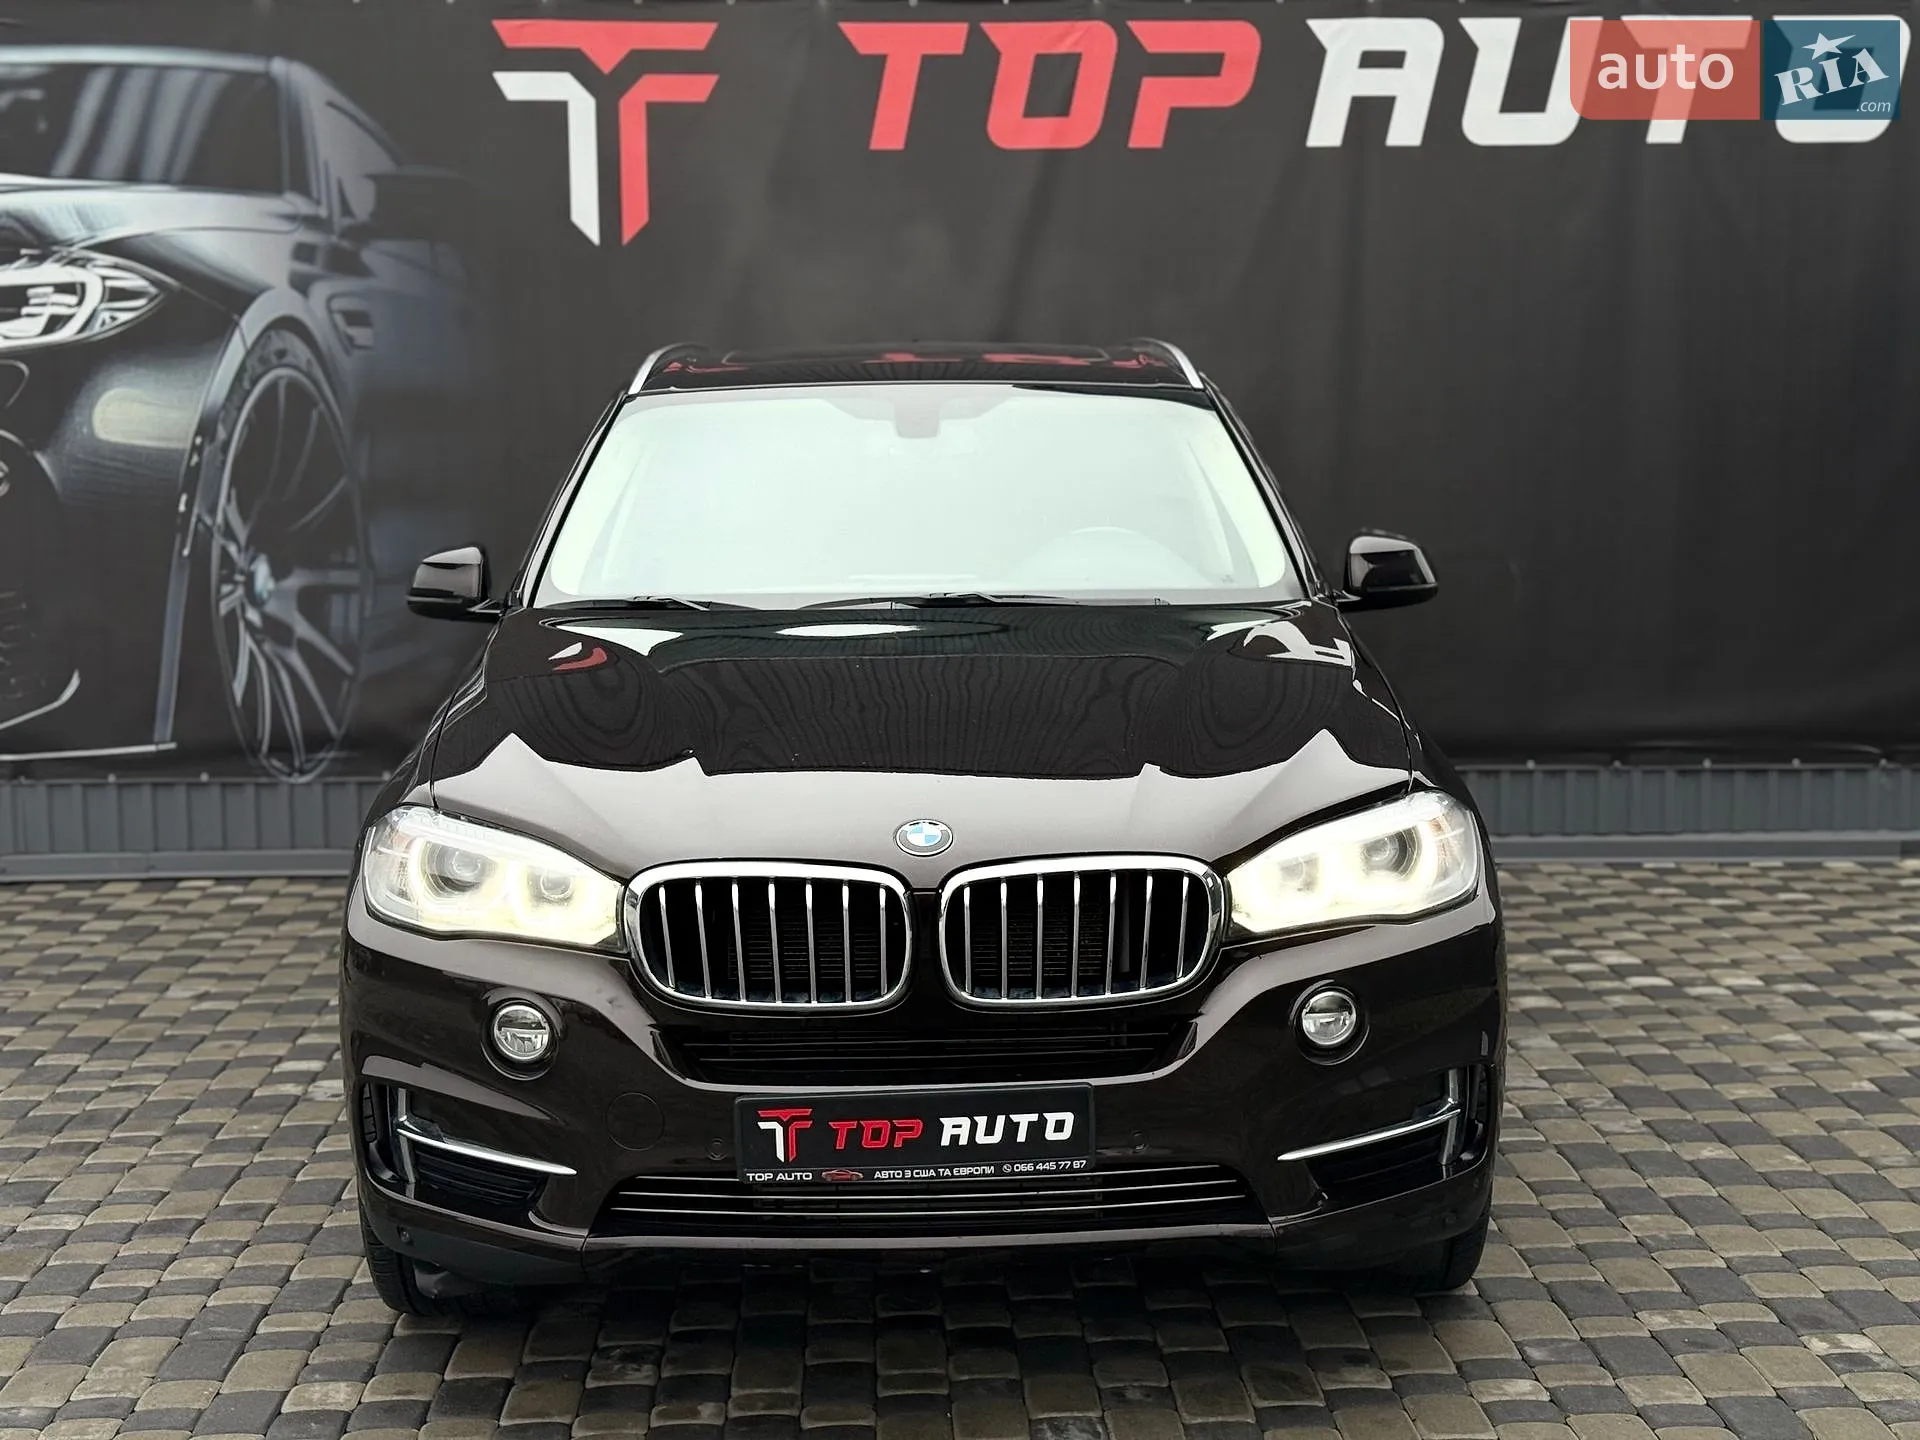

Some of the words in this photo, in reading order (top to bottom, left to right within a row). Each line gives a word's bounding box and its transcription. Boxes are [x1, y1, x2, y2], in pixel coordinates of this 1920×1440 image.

[837, 20, 1262, 151] TOP
[1305, 15, 1911, 147] AUTO
[828, 1119, 923, 1149] TOP
[939, 1111, 1075, 1146] AUTO
[1013, 1164, 1034, 1172] 066
[1036, 1162, 1056, 1170] 445
[1058, 1161, 1071, 1170] 77
[746, 1173, 774, 1182] TOP
[776, 1172, 813, 1181] AUTO
[913, 1169, 936, 1178] США
[938, 1168, 952, 1177] ТА
